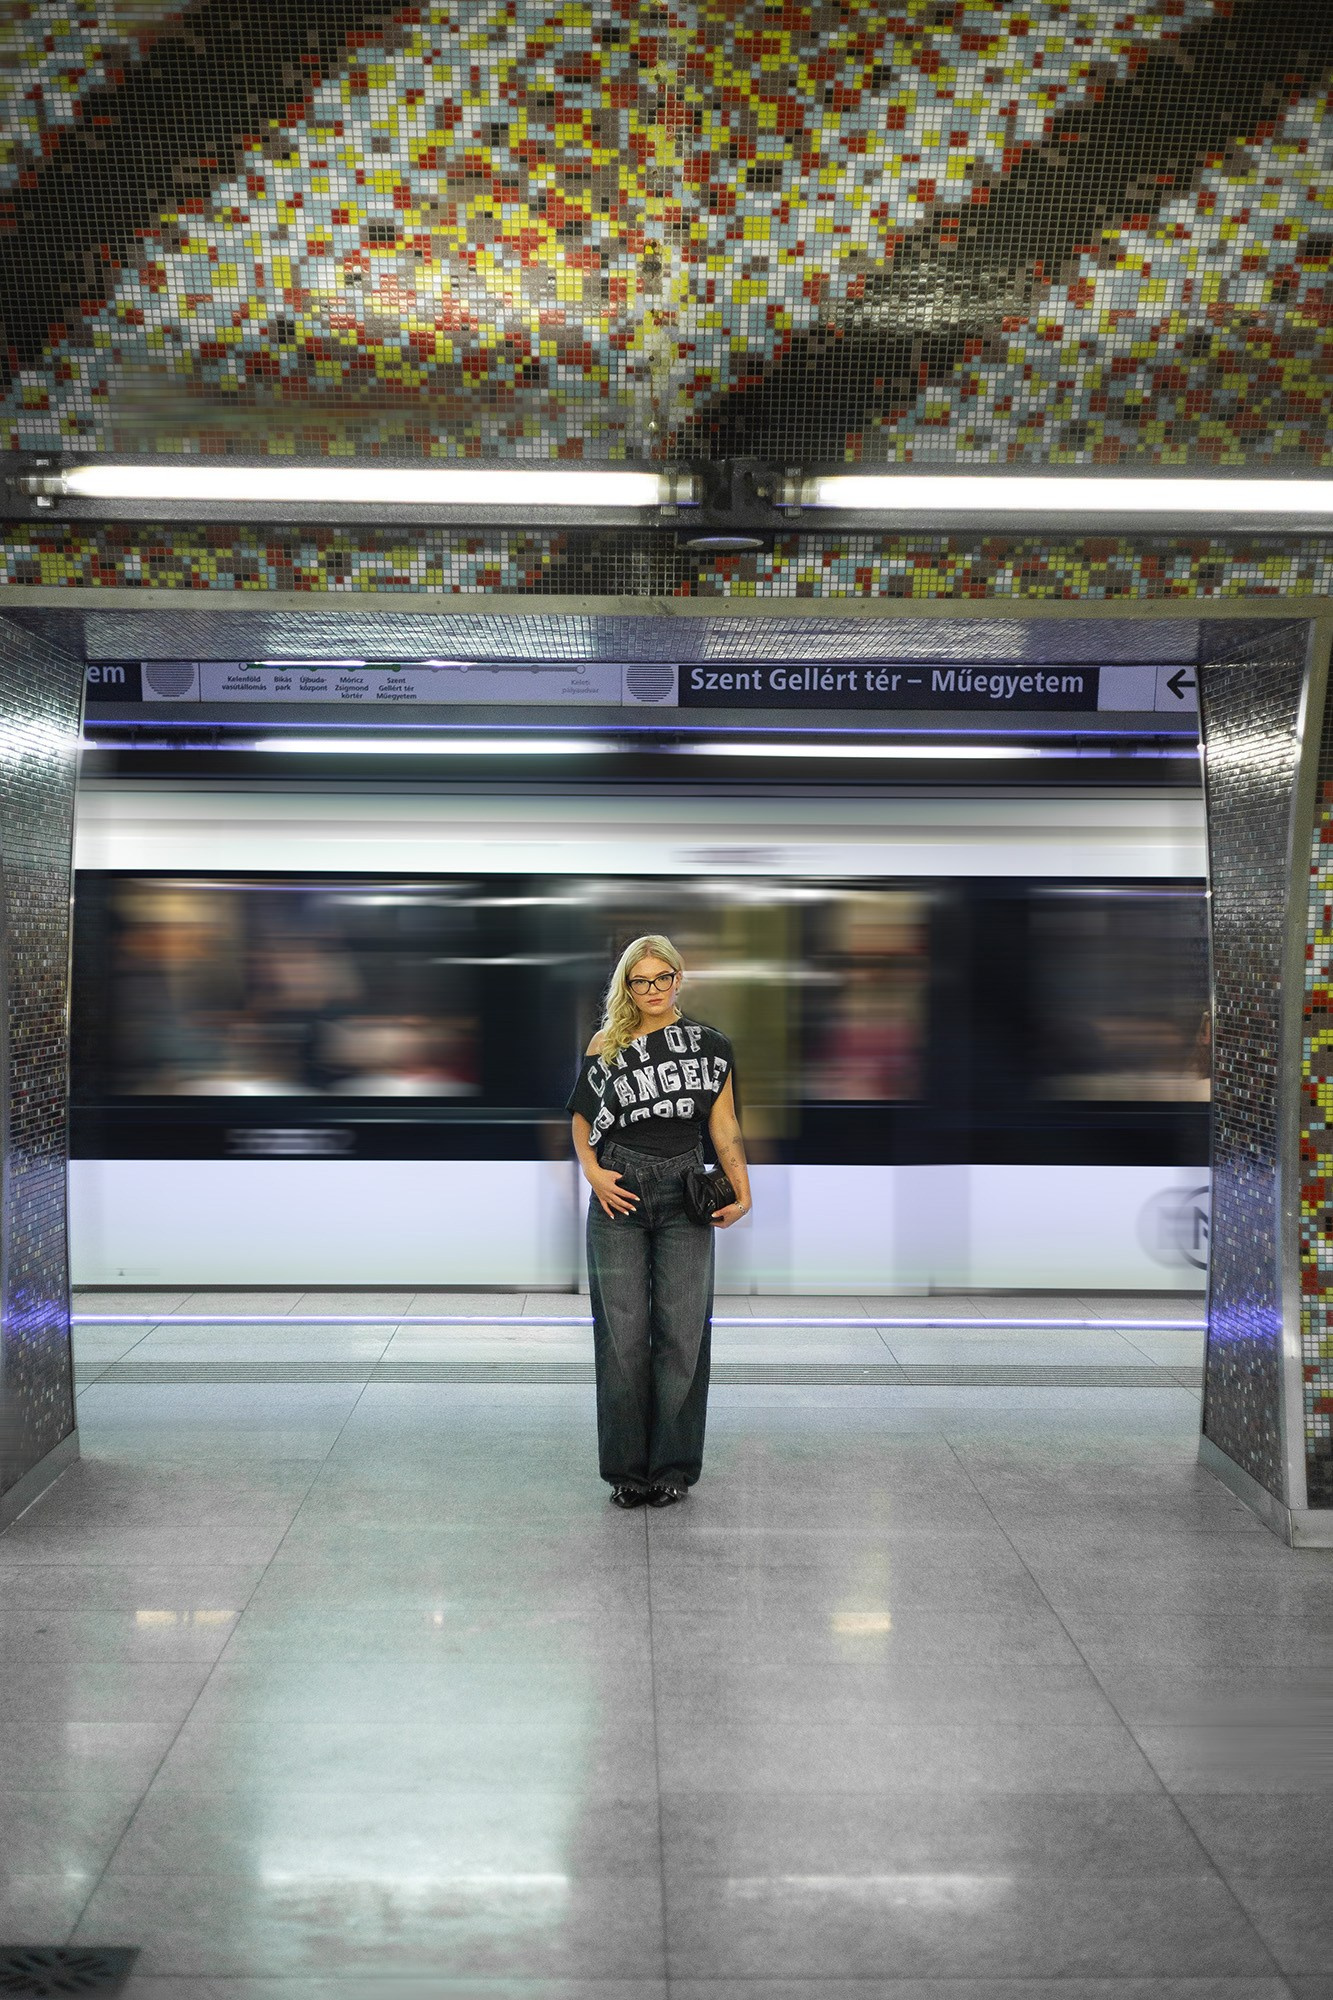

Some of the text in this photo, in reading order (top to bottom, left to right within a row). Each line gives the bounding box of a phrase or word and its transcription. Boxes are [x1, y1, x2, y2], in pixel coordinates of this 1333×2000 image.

[275, 684, 292, 692] park
[690, 668, 762, 691] Szent
[769, 667, 858, 692] Gellért
[864, 668, 902, 692] tér
[931, 668, 1084, 699] Műegyetem
[663, 1025, 702, 1054] OF
